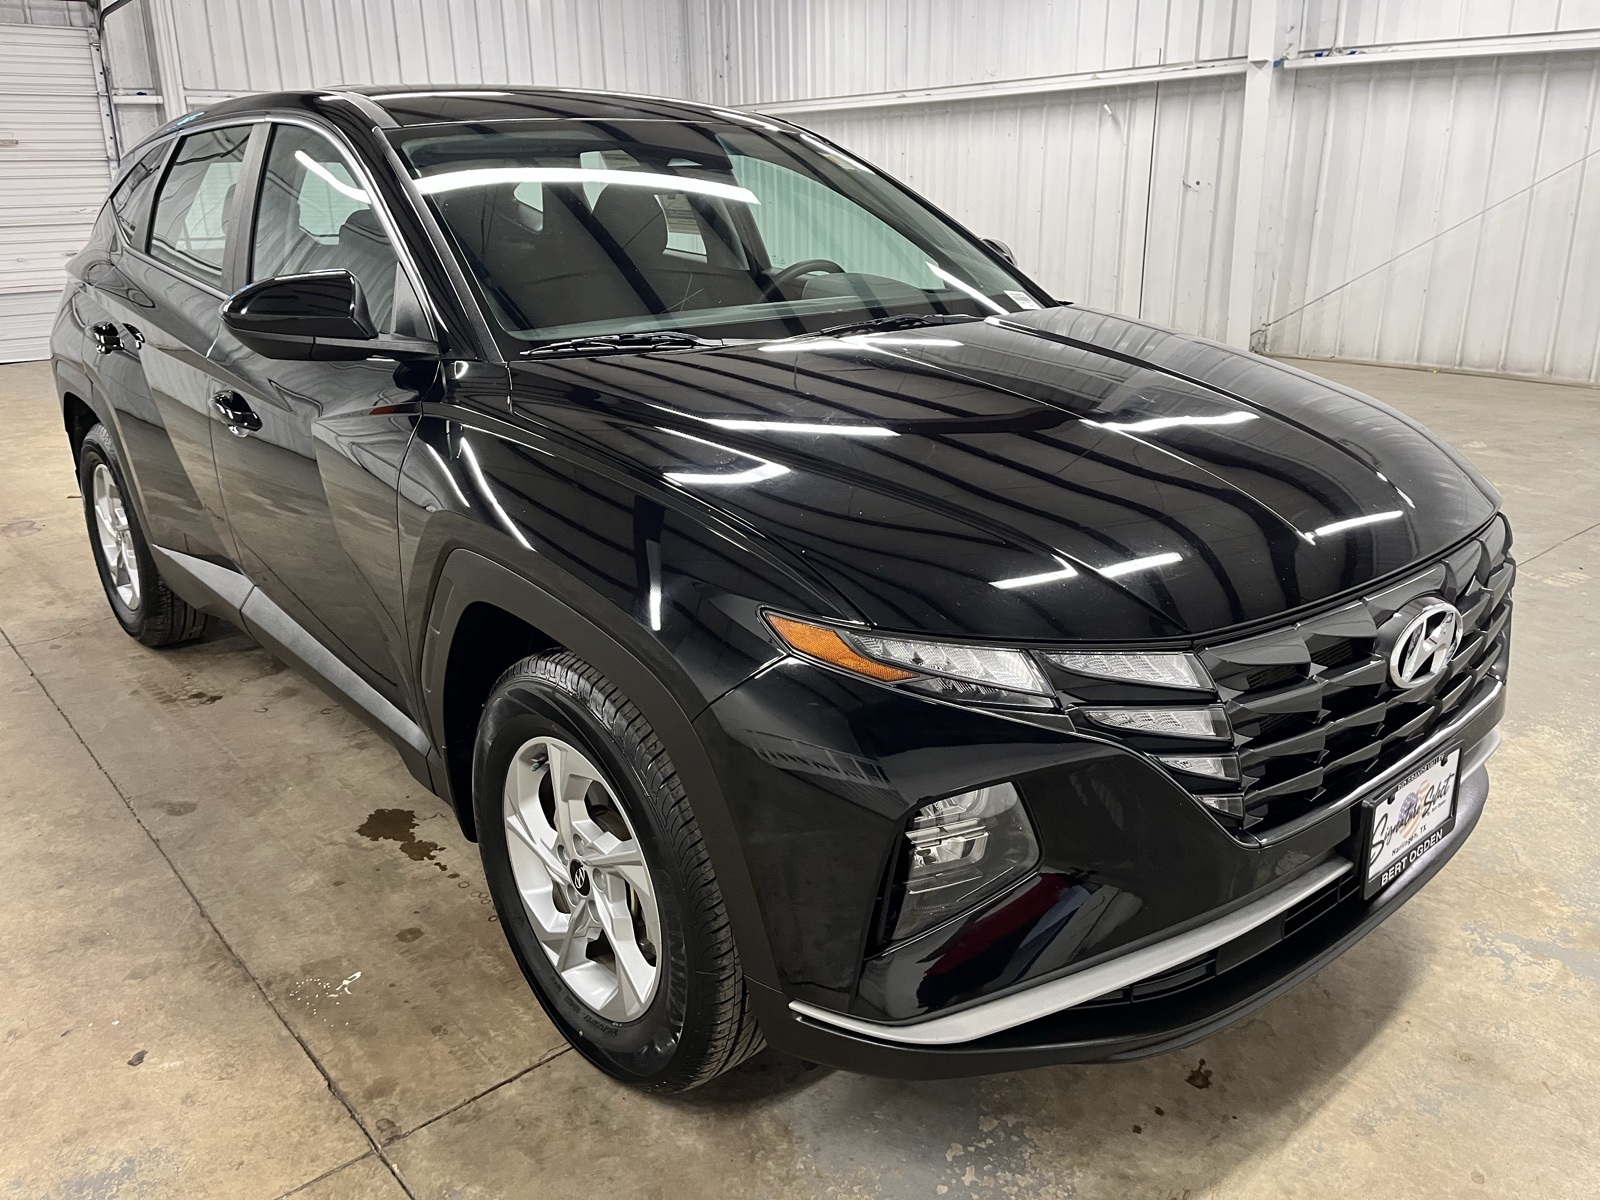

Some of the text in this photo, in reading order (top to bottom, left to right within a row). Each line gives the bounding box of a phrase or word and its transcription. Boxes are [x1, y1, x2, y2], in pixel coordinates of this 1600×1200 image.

[1422, 773, 1455, 819] Select
[1420, 824, 1427, 834] TX
[1381, 828, 1443, 887] BERT OGDEN
